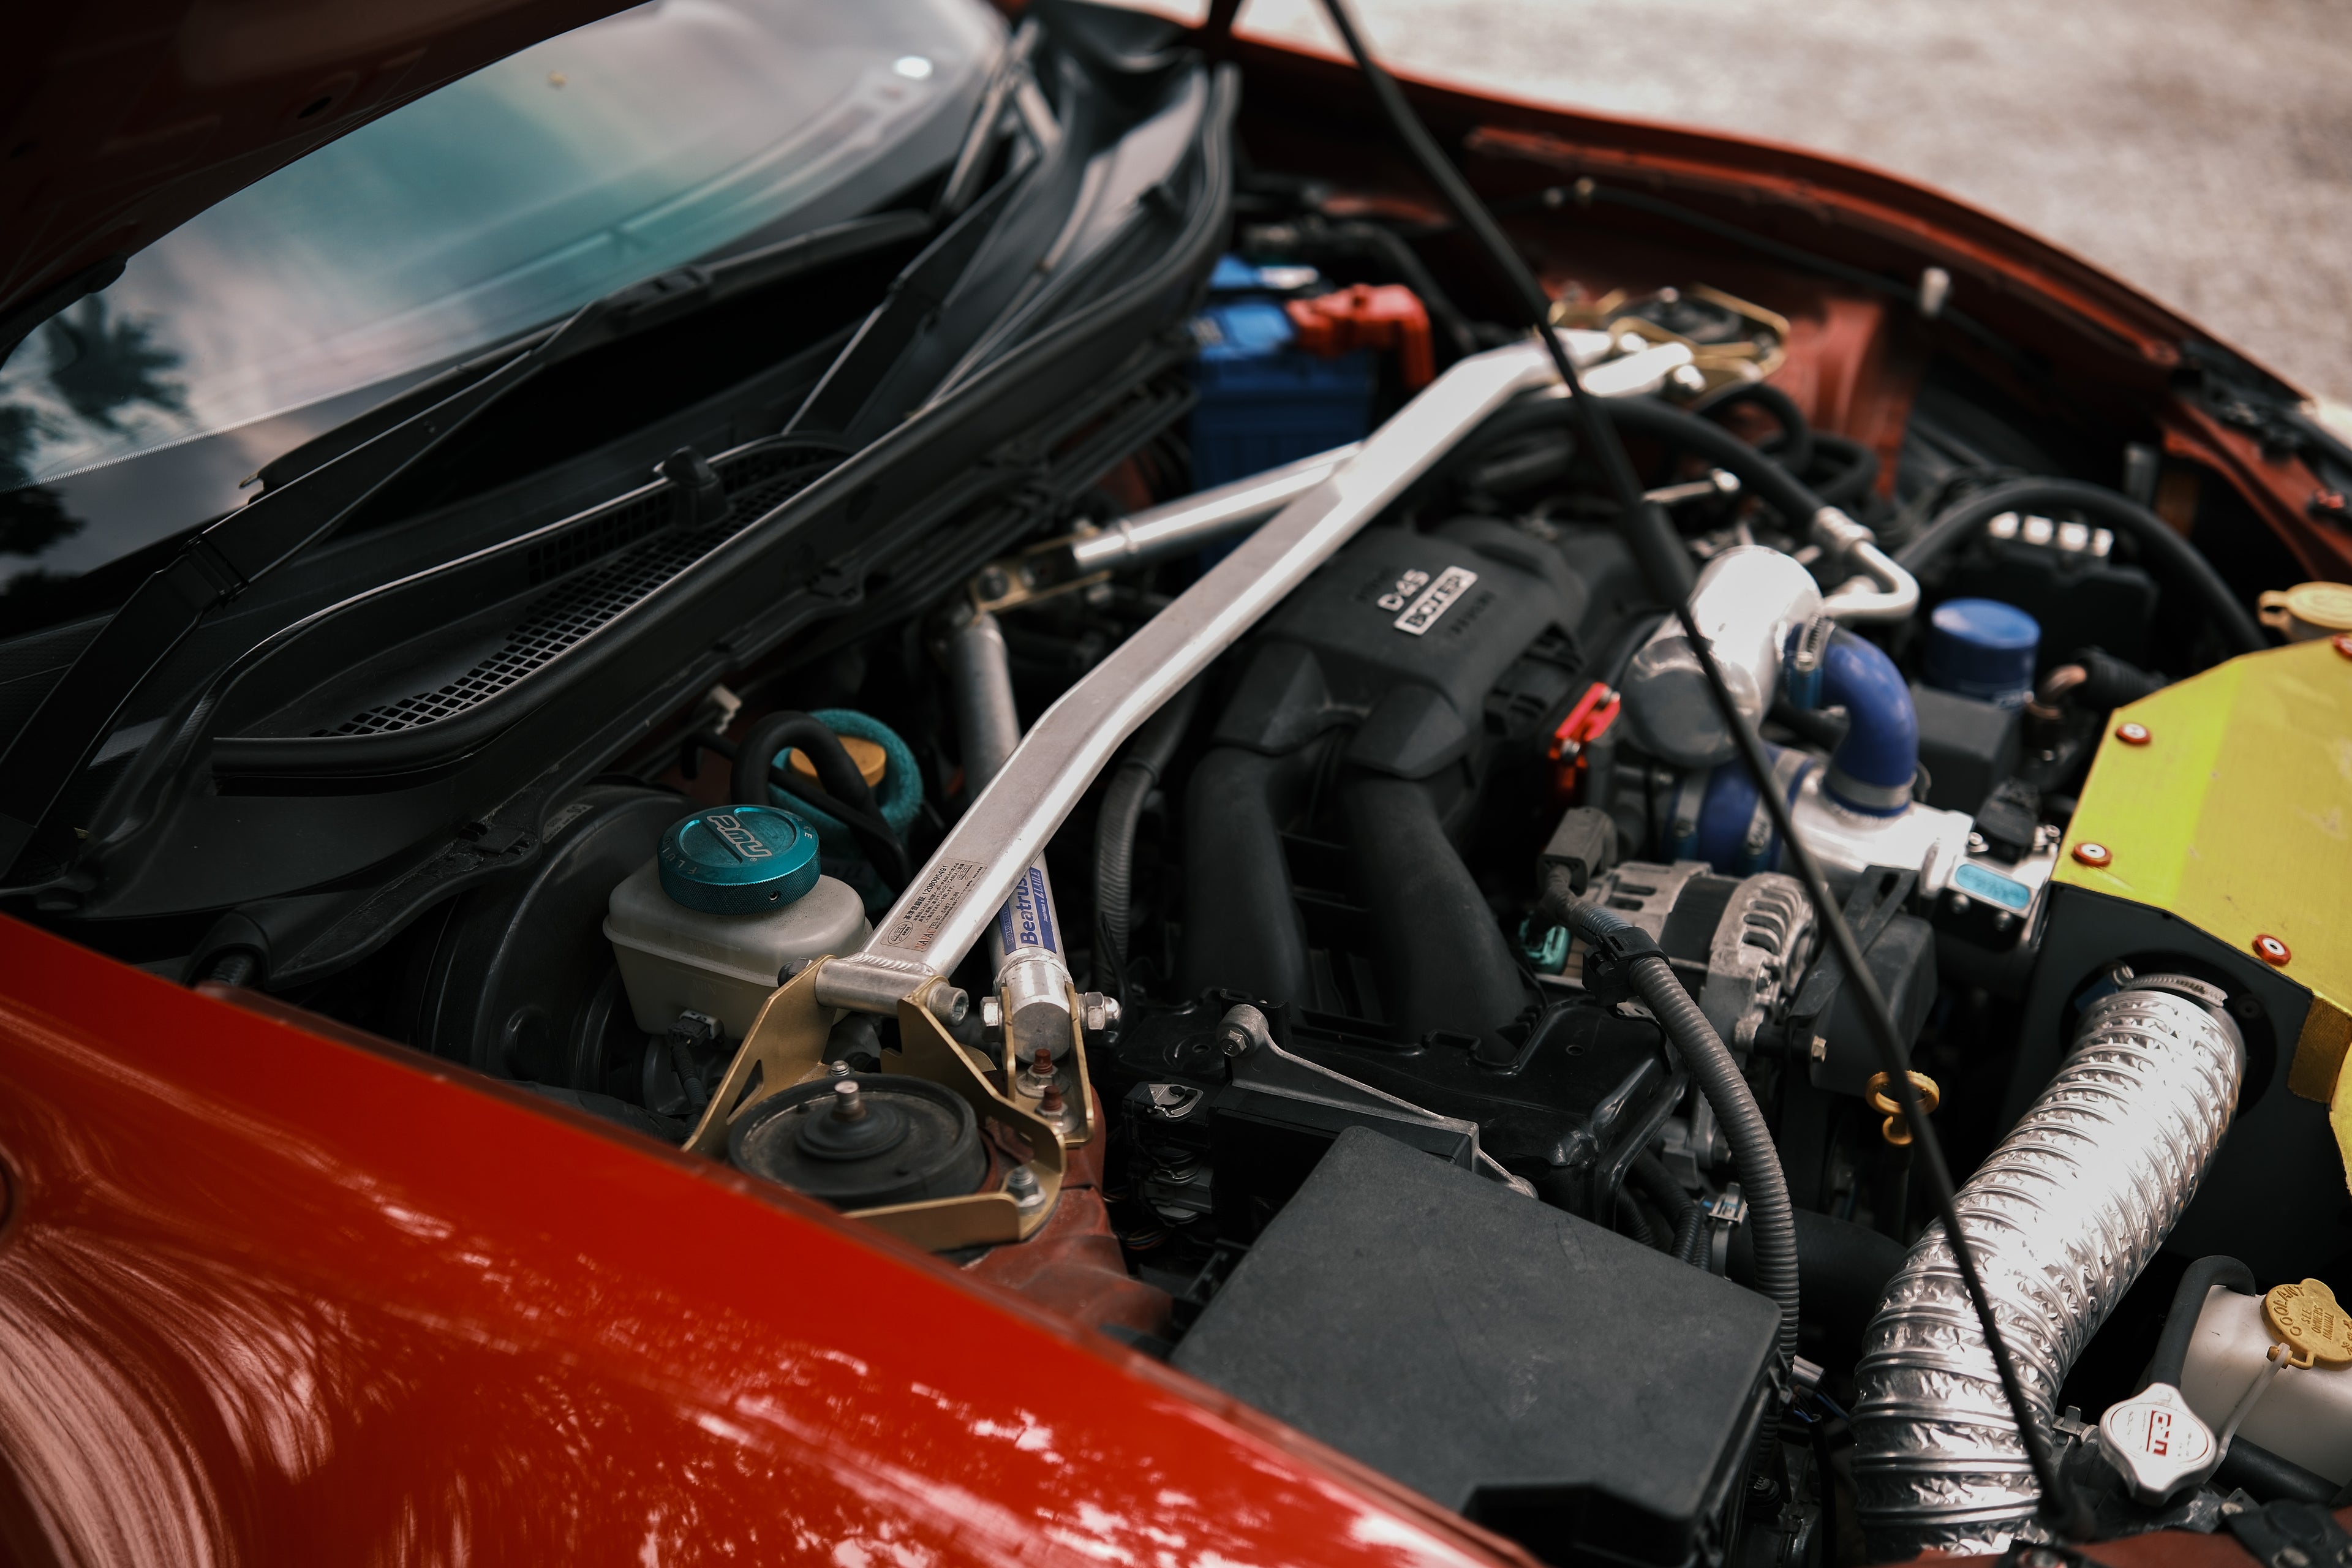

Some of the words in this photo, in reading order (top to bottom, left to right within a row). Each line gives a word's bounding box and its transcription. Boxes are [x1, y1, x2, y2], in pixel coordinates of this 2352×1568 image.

[922, 865, 949, 895] 1208095491
[928, 918, 938, 929] TEL
[1016, 875, 1039, 945] Beatrus
[914, 928, 937, 949] NAPAC
[2273, 1285, 2305, 1336] COOLANT
[2301, 1308, 2312, 1325] SEE
[2322, 1312, 2334, 1341] MANUAL
